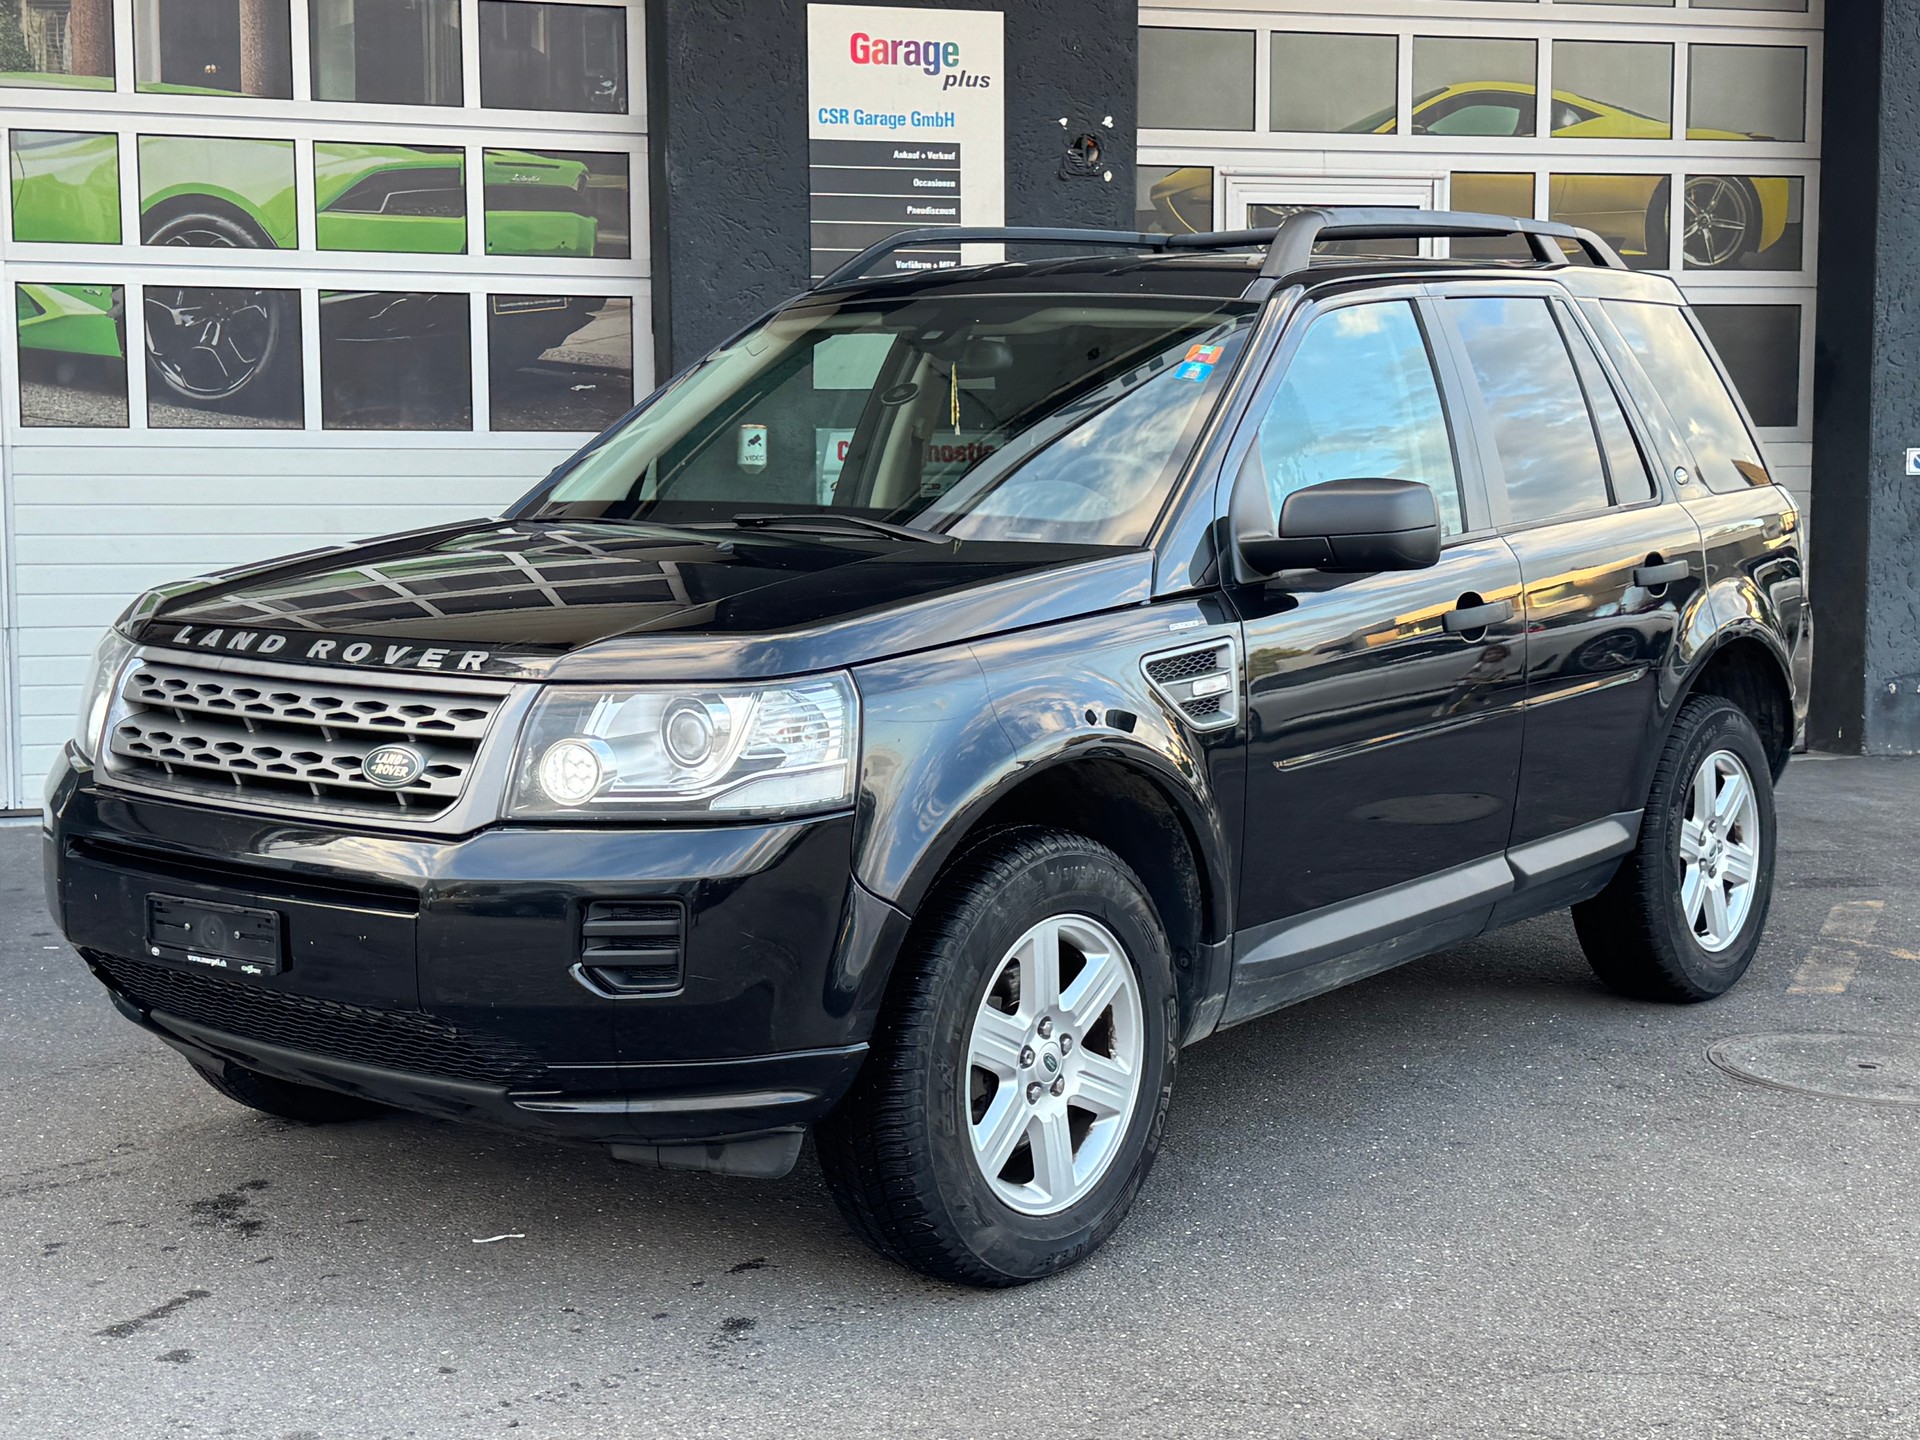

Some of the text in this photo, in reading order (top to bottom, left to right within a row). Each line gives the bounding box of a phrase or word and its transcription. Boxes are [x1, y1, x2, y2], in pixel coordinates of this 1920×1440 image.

[850, 32, 960, 76] Garage
[942, 70, 991, 91] plus
[818, 107, 955, 129] CSR Garage GmbH
[893, 150, 920, 159] Ankauf
[927, 151, 956, 160] Verkauf
[913, 178, 956, 188] Occasionen
[906, 205, 956, 216] Pneudiscount
[172, 625, 490, 672] LAND ROVER
[375, 753, 403, 766] LAND
[374, 763, 409, 778] ROVER
